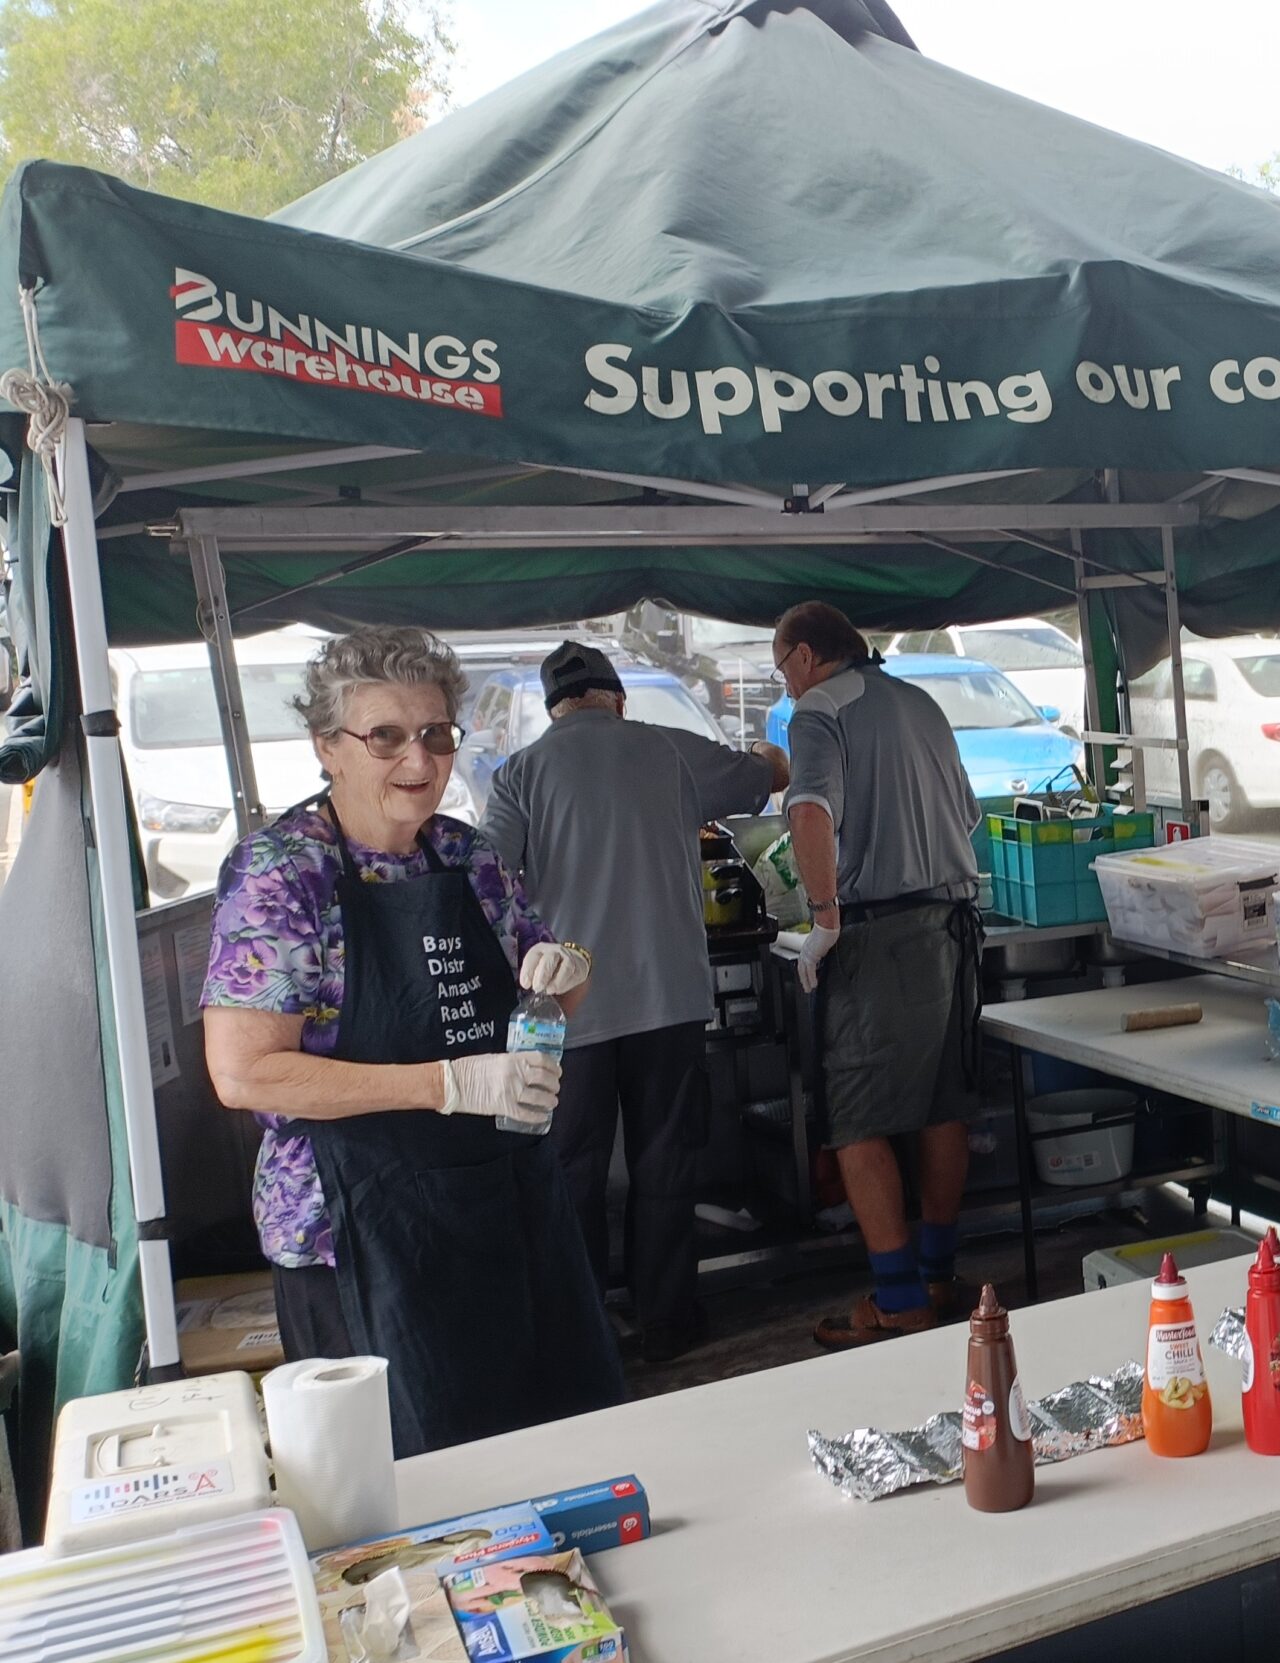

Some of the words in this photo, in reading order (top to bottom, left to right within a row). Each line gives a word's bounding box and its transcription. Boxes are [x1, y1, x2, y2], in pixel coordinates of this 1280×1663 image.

[170, 267, 501, 385] BUNNINGS
[583, 342, 1054, 435] Supporting
[1075, 360, 1182, 411] our
